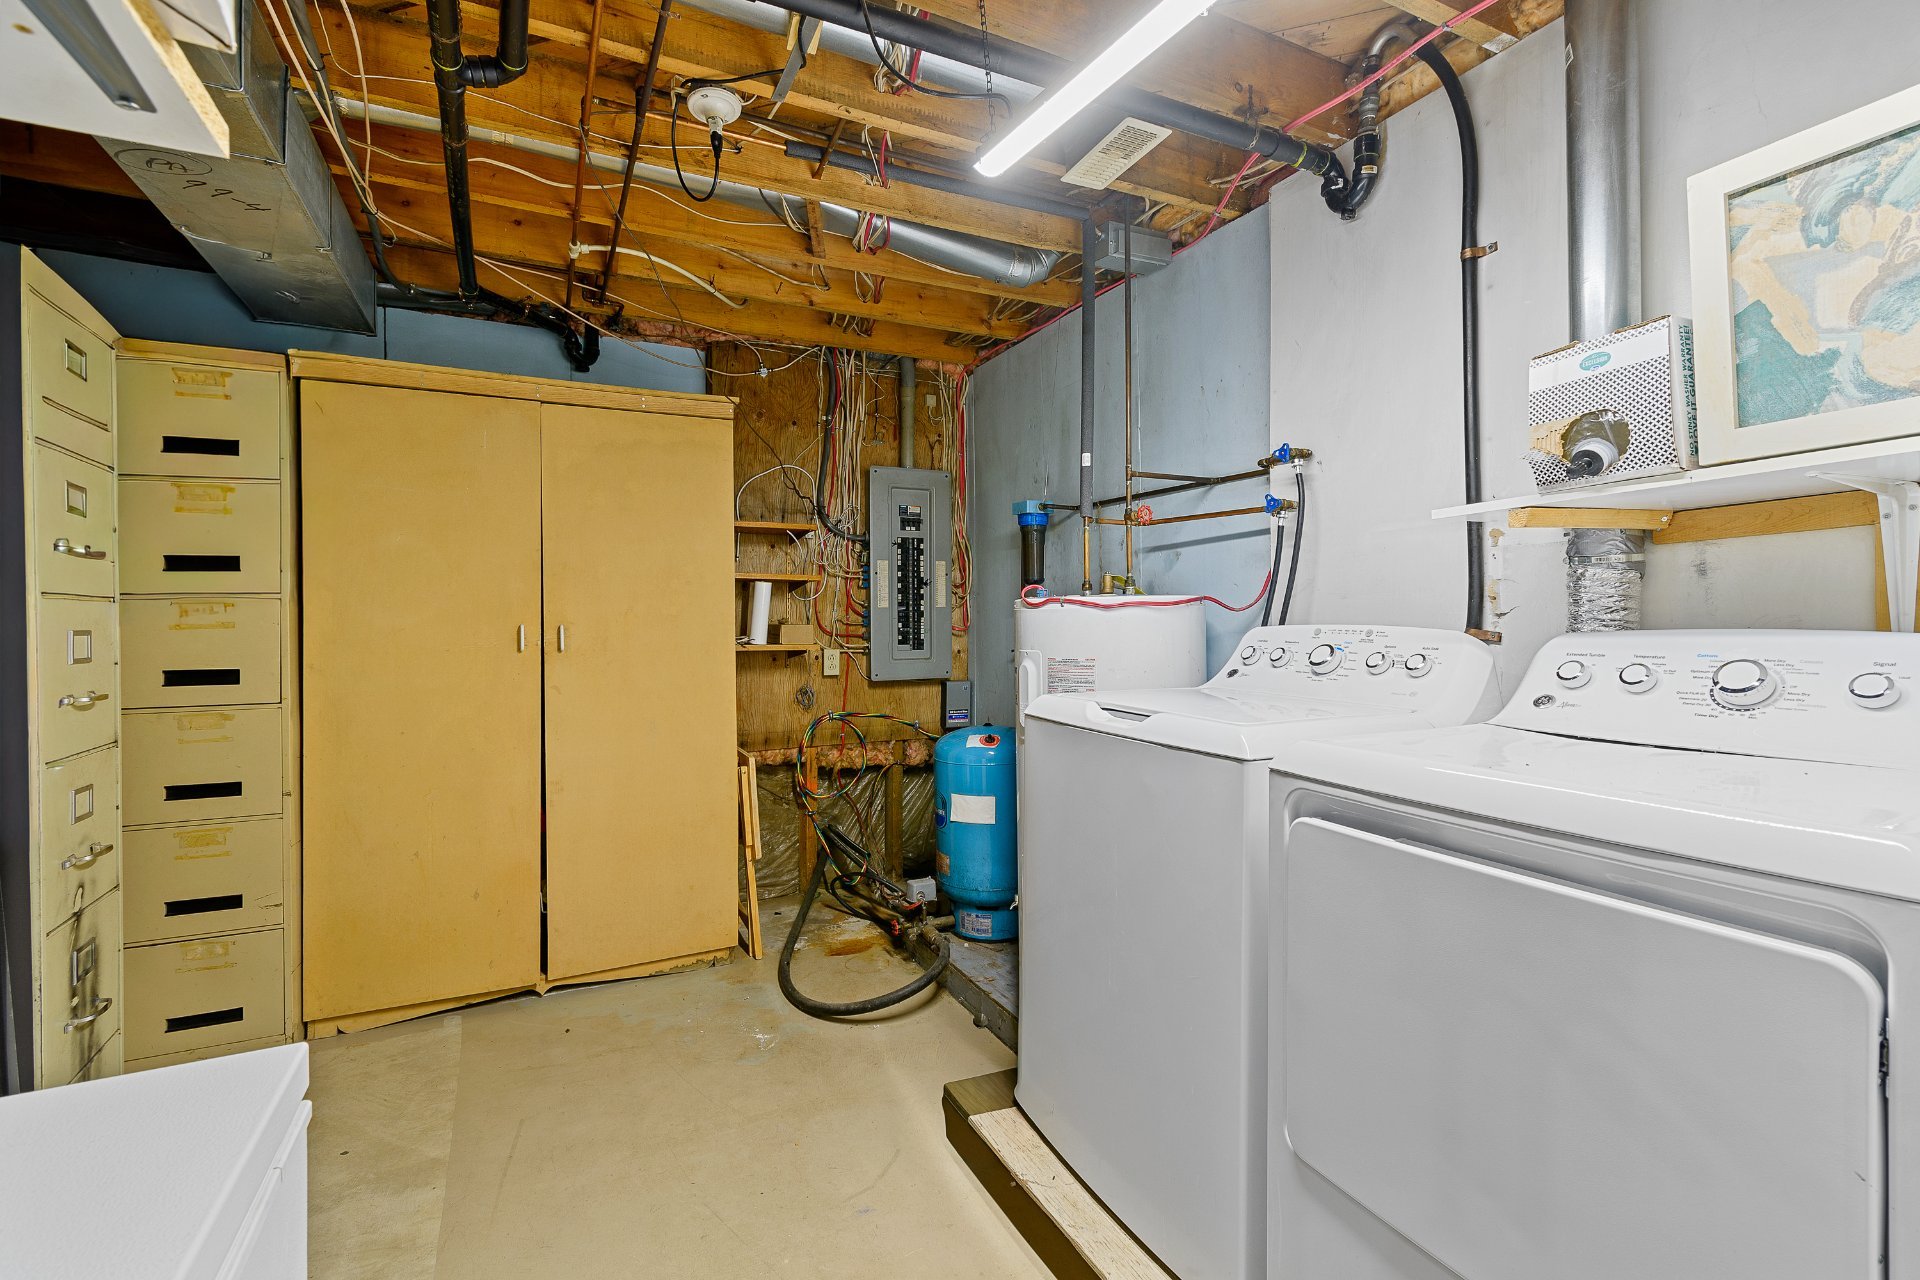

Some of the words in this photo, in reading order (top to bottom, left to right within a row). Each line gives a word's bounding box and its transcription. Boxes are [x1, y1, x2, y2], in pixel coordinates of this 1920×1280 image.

[1679, 325, 1687, 371] WARRANTY
[1683, 325, 1696, 397] GUARANTEE!
[1683, 374, 1691, 407] WASHER
[1690, 401, 1697, 411] IT
[1689, 442, 1695, 456] NO
